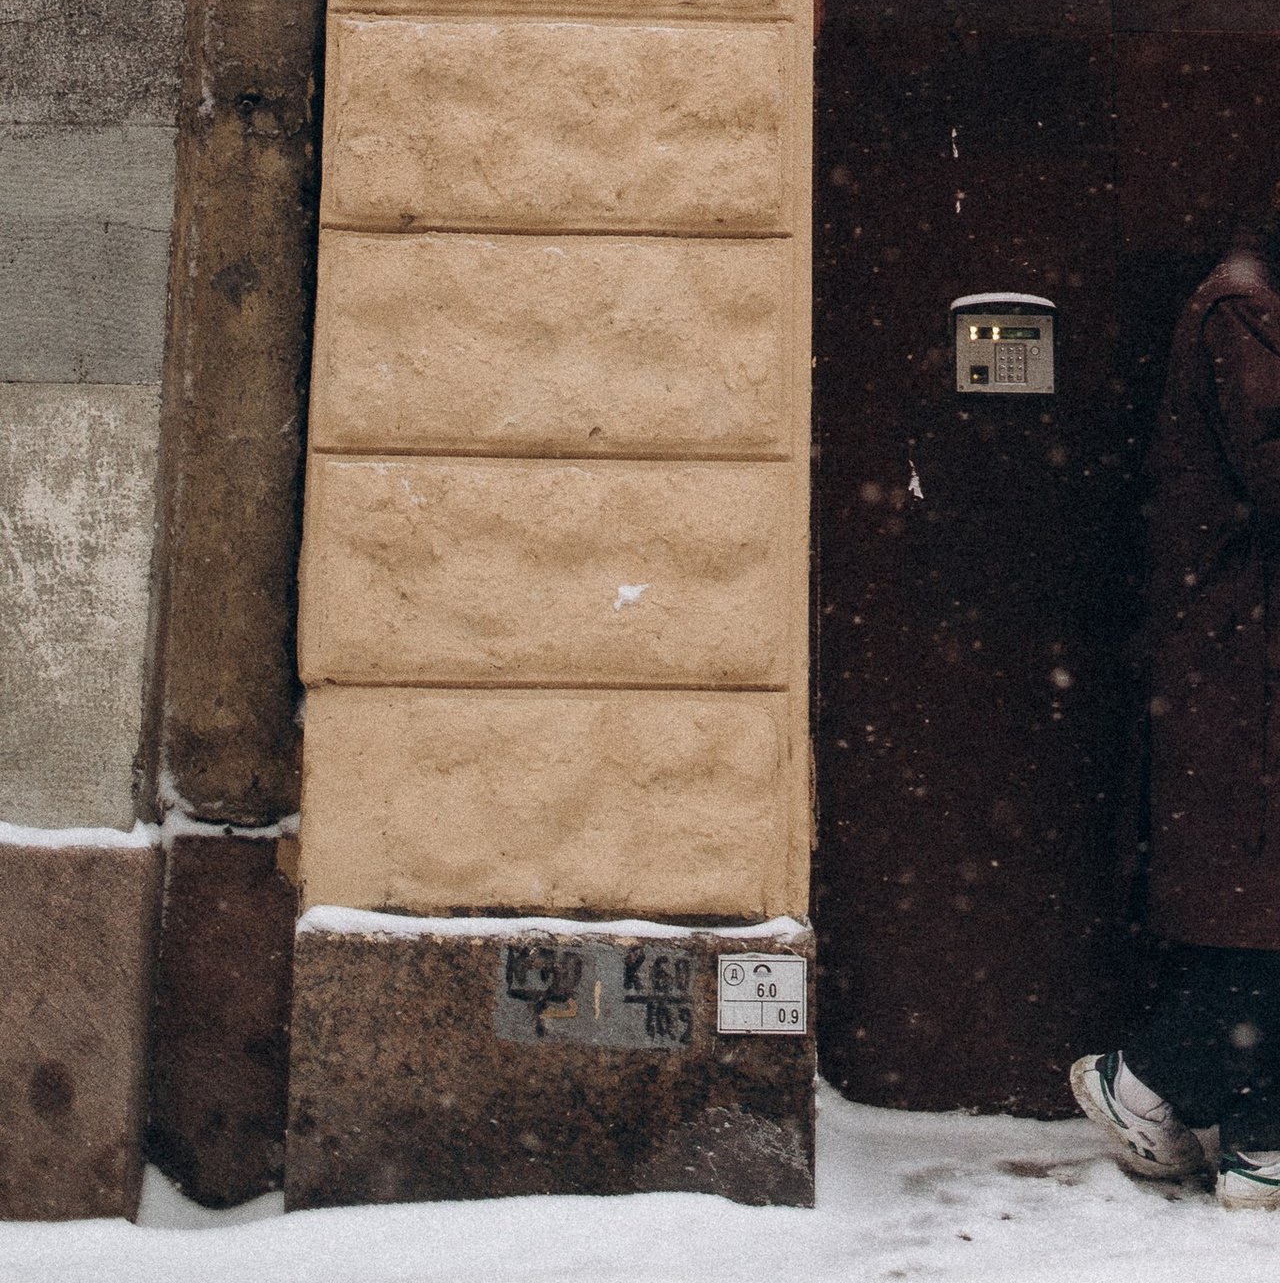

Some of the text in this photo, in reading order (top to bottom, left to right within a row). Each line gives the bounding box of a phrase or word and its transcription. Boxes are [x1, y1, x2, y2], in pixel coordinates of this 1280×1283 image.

[731, 968, 738, 980] Д
[757, 983, 777, 998] 6.0
[778, 1008, 799, 1024] 0.9
